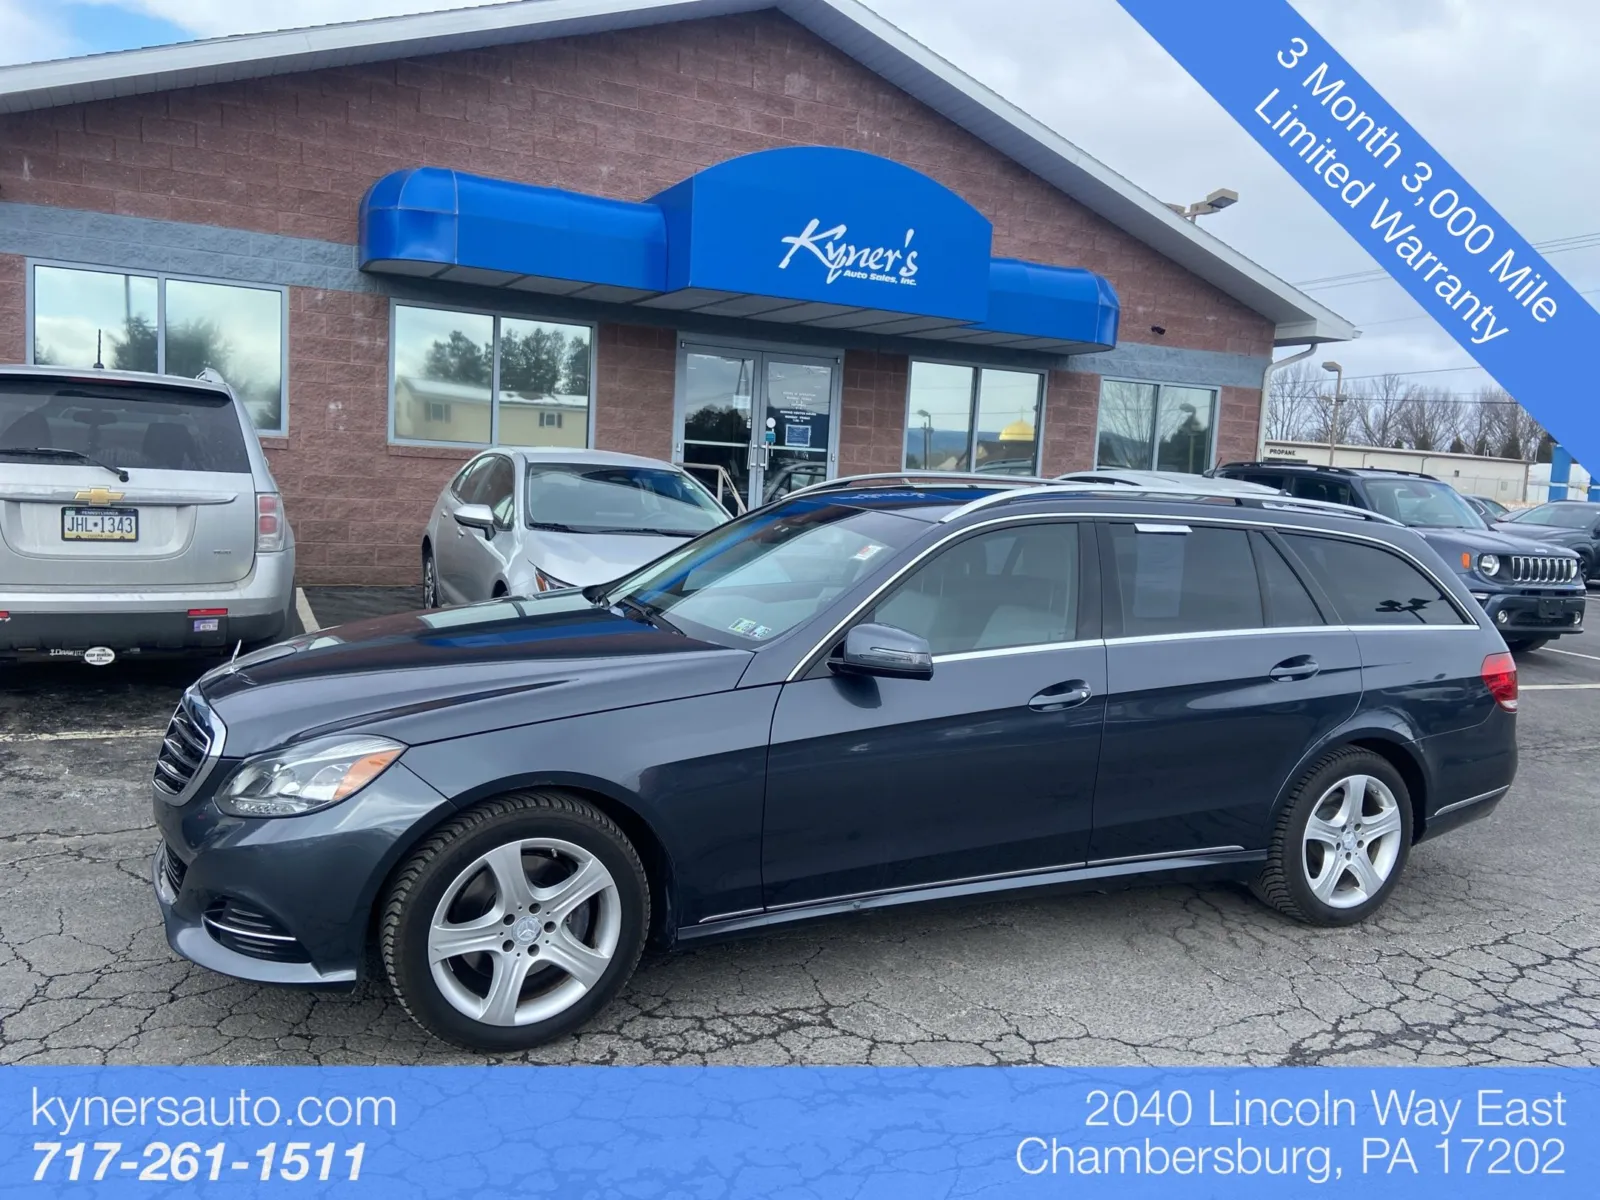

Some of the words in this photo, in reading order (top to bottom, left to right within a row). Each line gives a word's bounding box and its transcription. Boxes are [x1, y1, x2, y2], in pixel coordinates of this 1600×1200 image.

[778, 218, 918, 284] Kyner's
[843, 269, 868, 280] Auto
[869, 273, 898, 285] Sales,
[900, 276, 917, 286] Inc.
[1269, 448, 1296, 456] PROPANE
